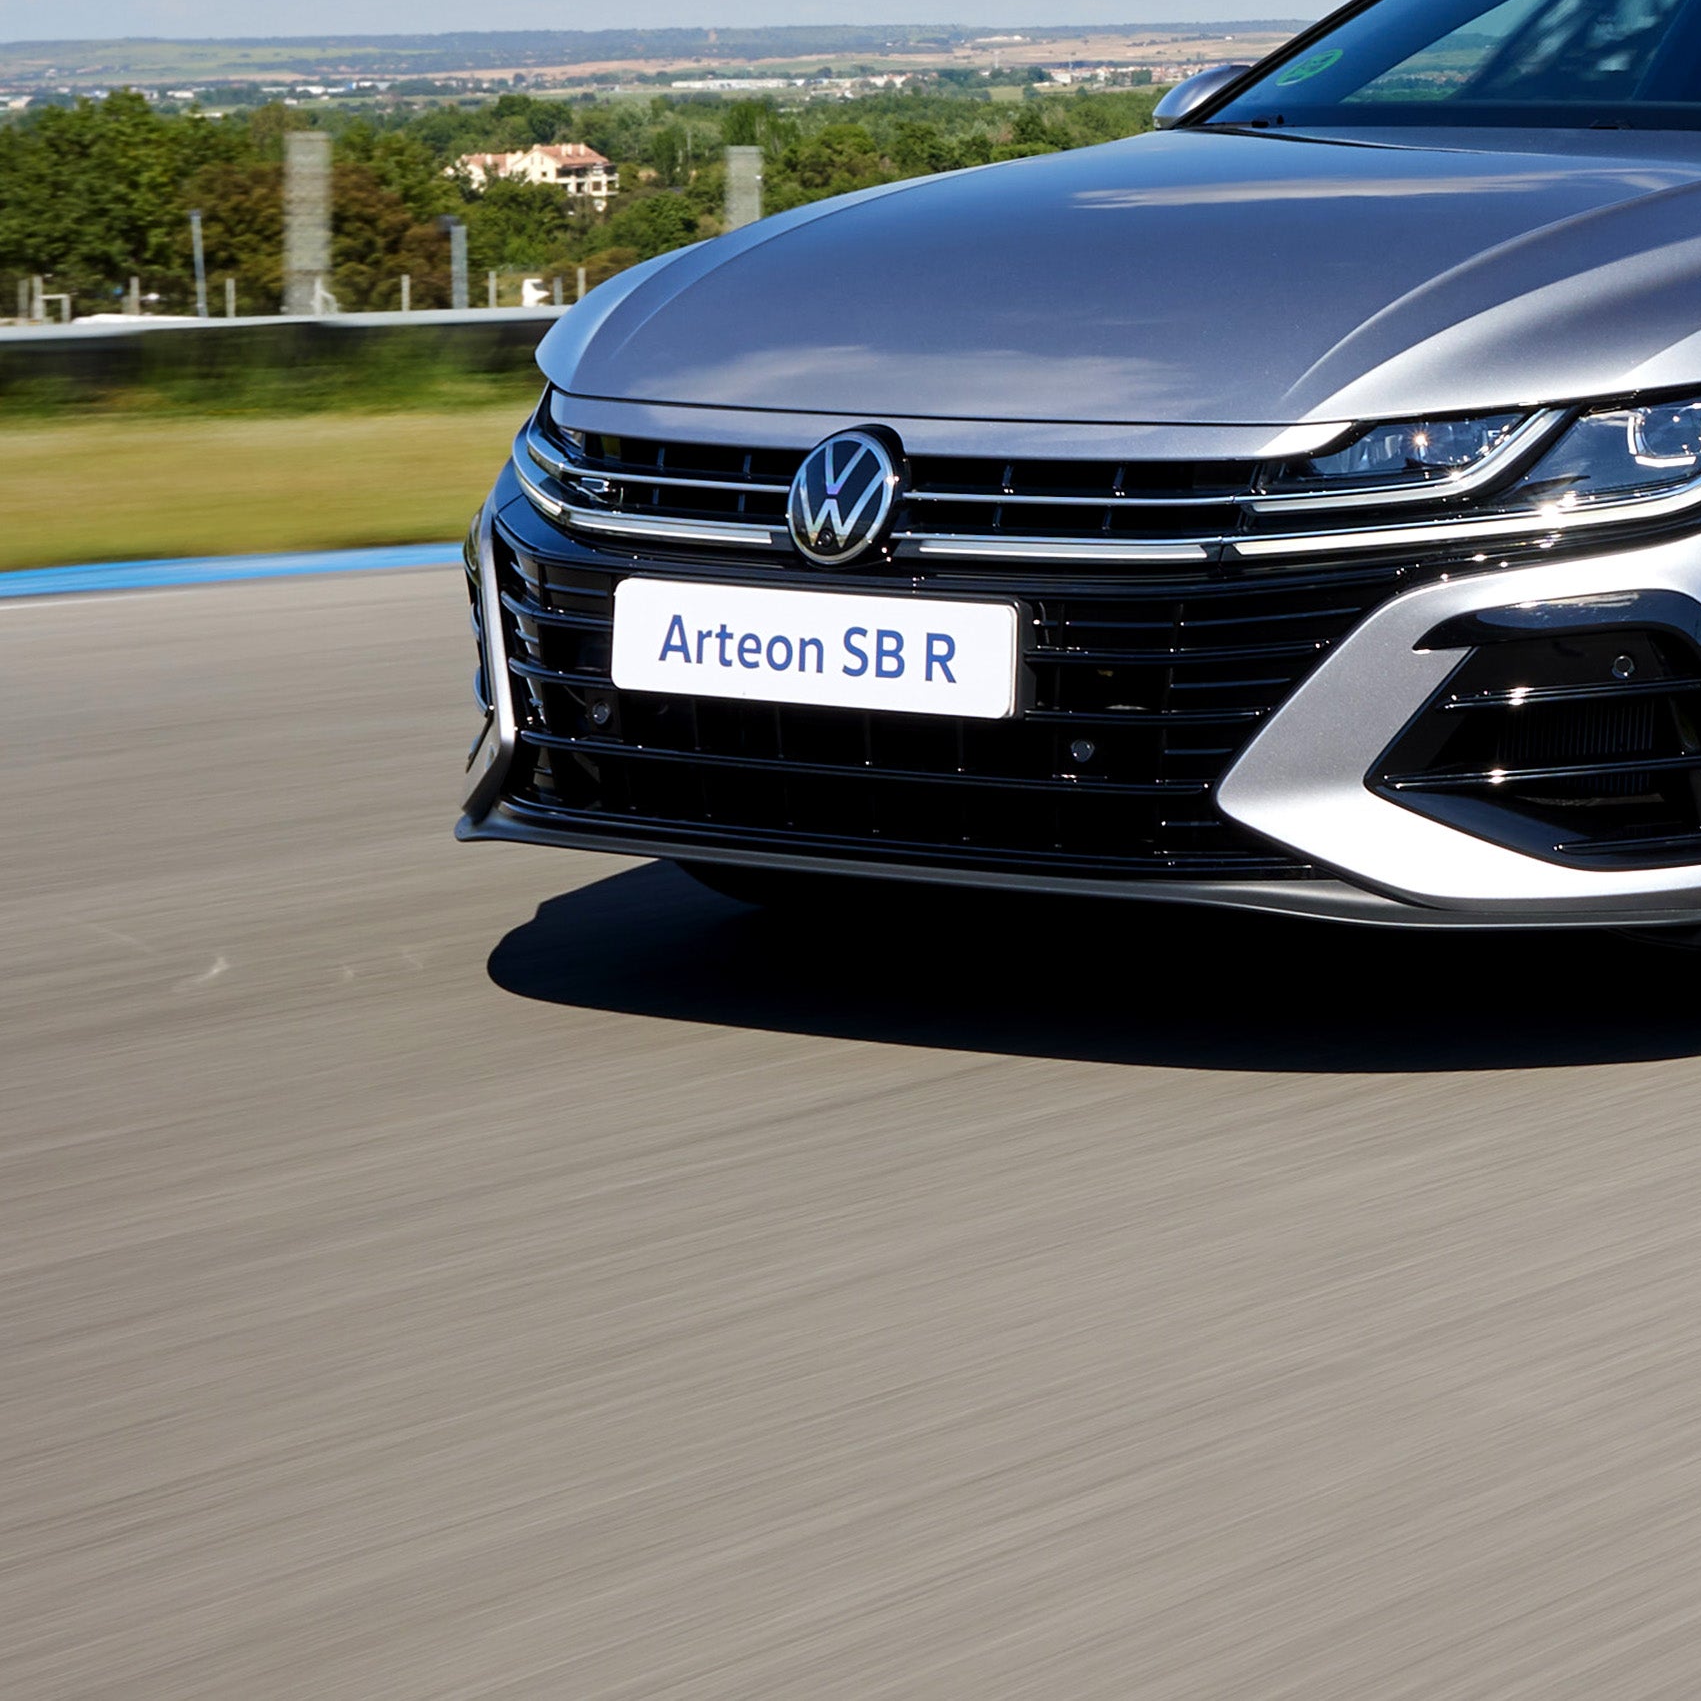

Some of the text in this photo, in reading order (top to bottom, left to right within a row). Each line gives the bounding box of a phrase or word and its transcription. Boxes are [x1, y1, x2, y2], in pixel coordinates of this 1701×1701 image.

[657, 614, 958, 685] Arteon SB R
